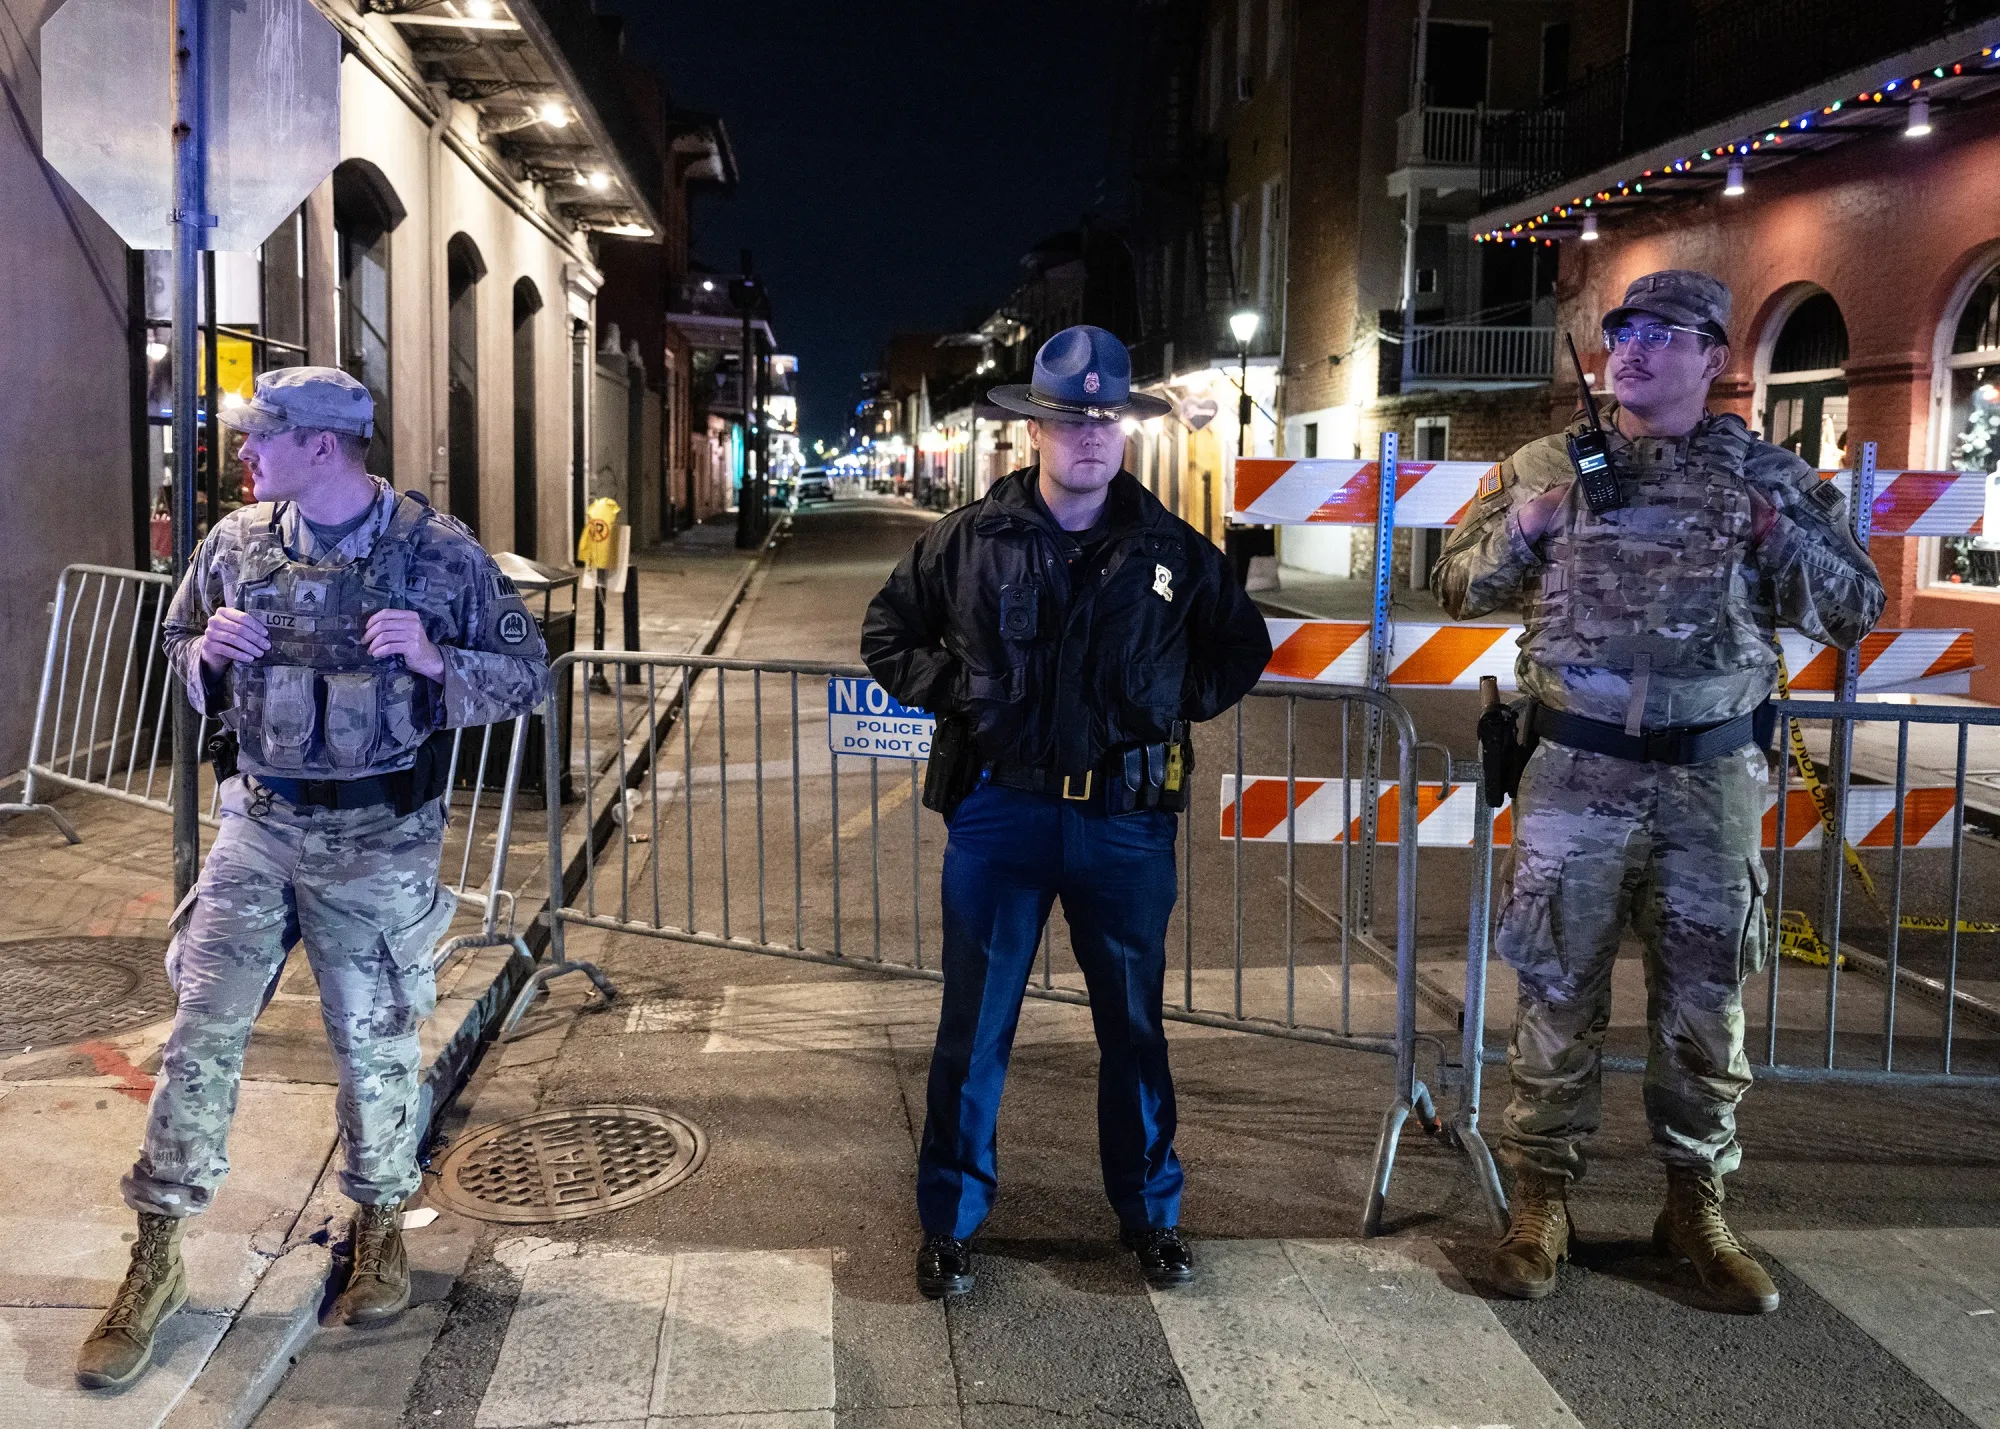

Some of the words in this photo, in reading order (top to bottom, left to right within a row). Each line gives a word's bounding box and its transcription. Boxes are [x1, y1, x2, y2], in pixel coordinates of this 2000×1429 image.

[266, 613, 295, 628] LOTZ
[856, 720, 923, 736] POLICE
[844, 736, 870, 749] DO
[875, 739, 912, 752] NOT
[539, 1122, 600, 1207] DRAIN
